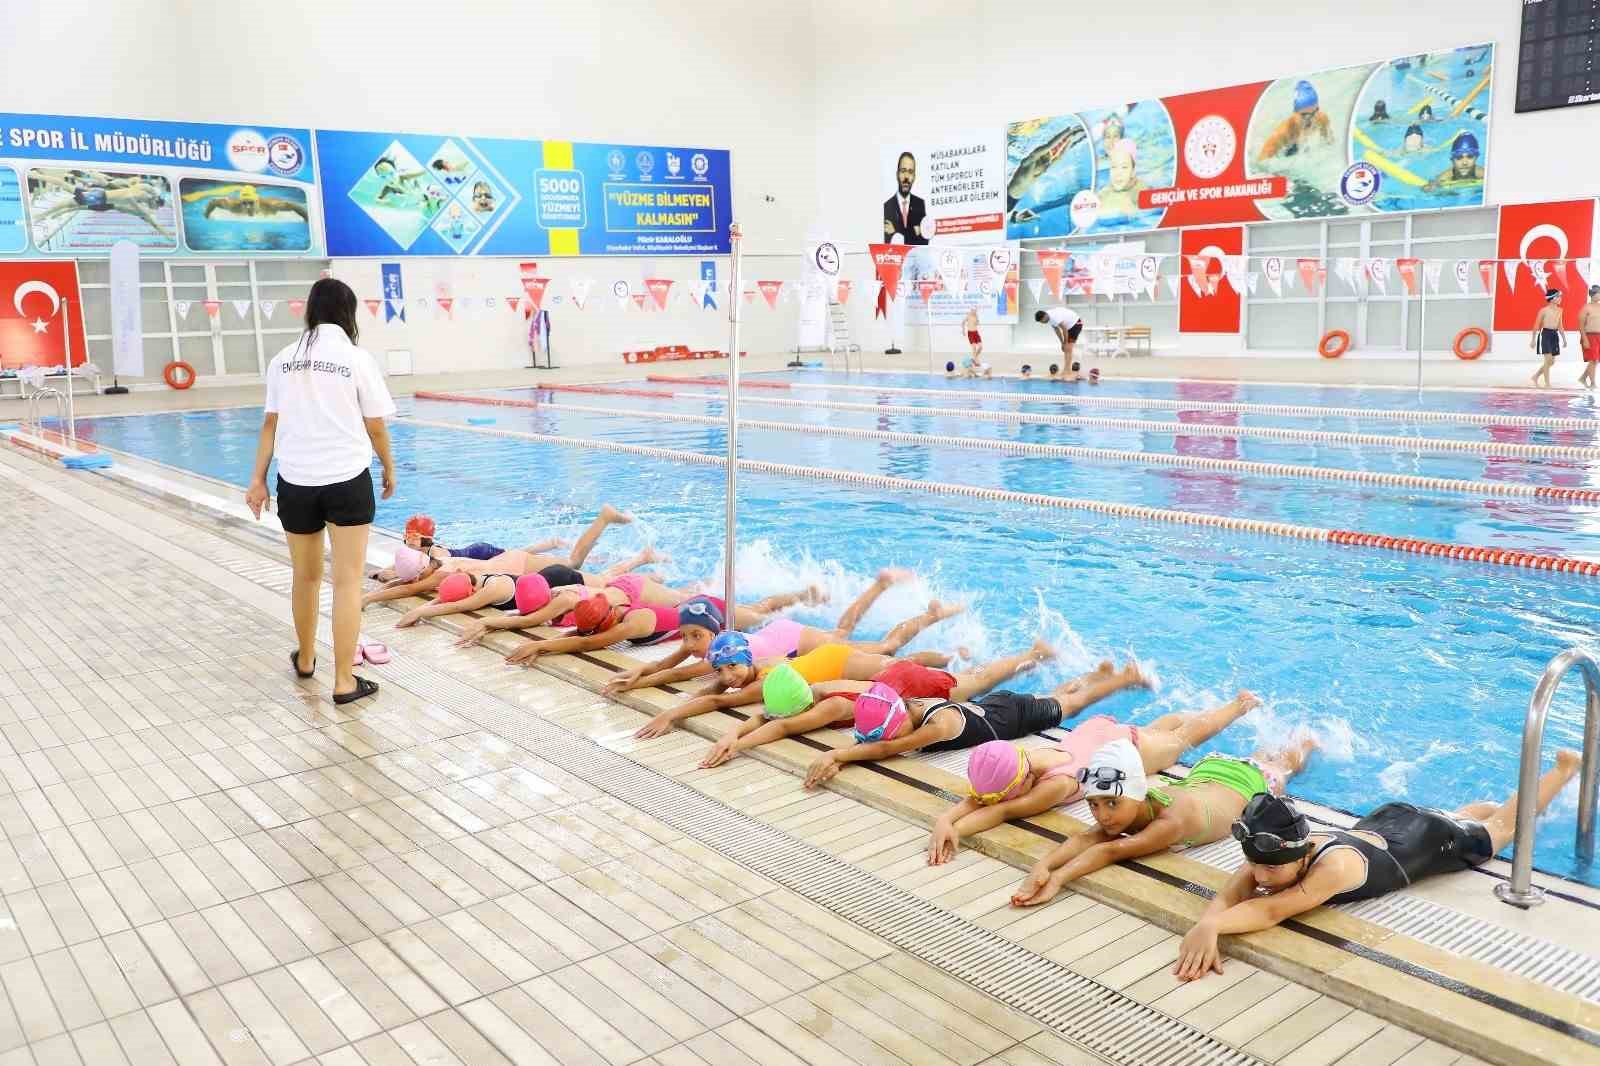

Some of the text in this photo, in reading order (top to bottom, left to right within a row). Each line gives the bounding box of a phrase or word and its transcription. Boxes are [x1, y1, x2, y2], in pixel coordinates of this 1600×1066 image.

[9, 128, 65, 149] SPOR
[71, 127, 89, 151] İL
[94, 132, 212, 162] MÜDÜRLÜĞÜ
[232, 144, 265, 154] SPOR
[930, 160, 959, 171] KATILAN
[930, 168, 984, 183] TÜM SPORCU VE
[540, 177, 579, 193] 5000
[1151, 180, 1273, 205] GENÇLİK VE SPOR BAKANLIĞI
[656, 191, 710, 207] BİLMEYEN
